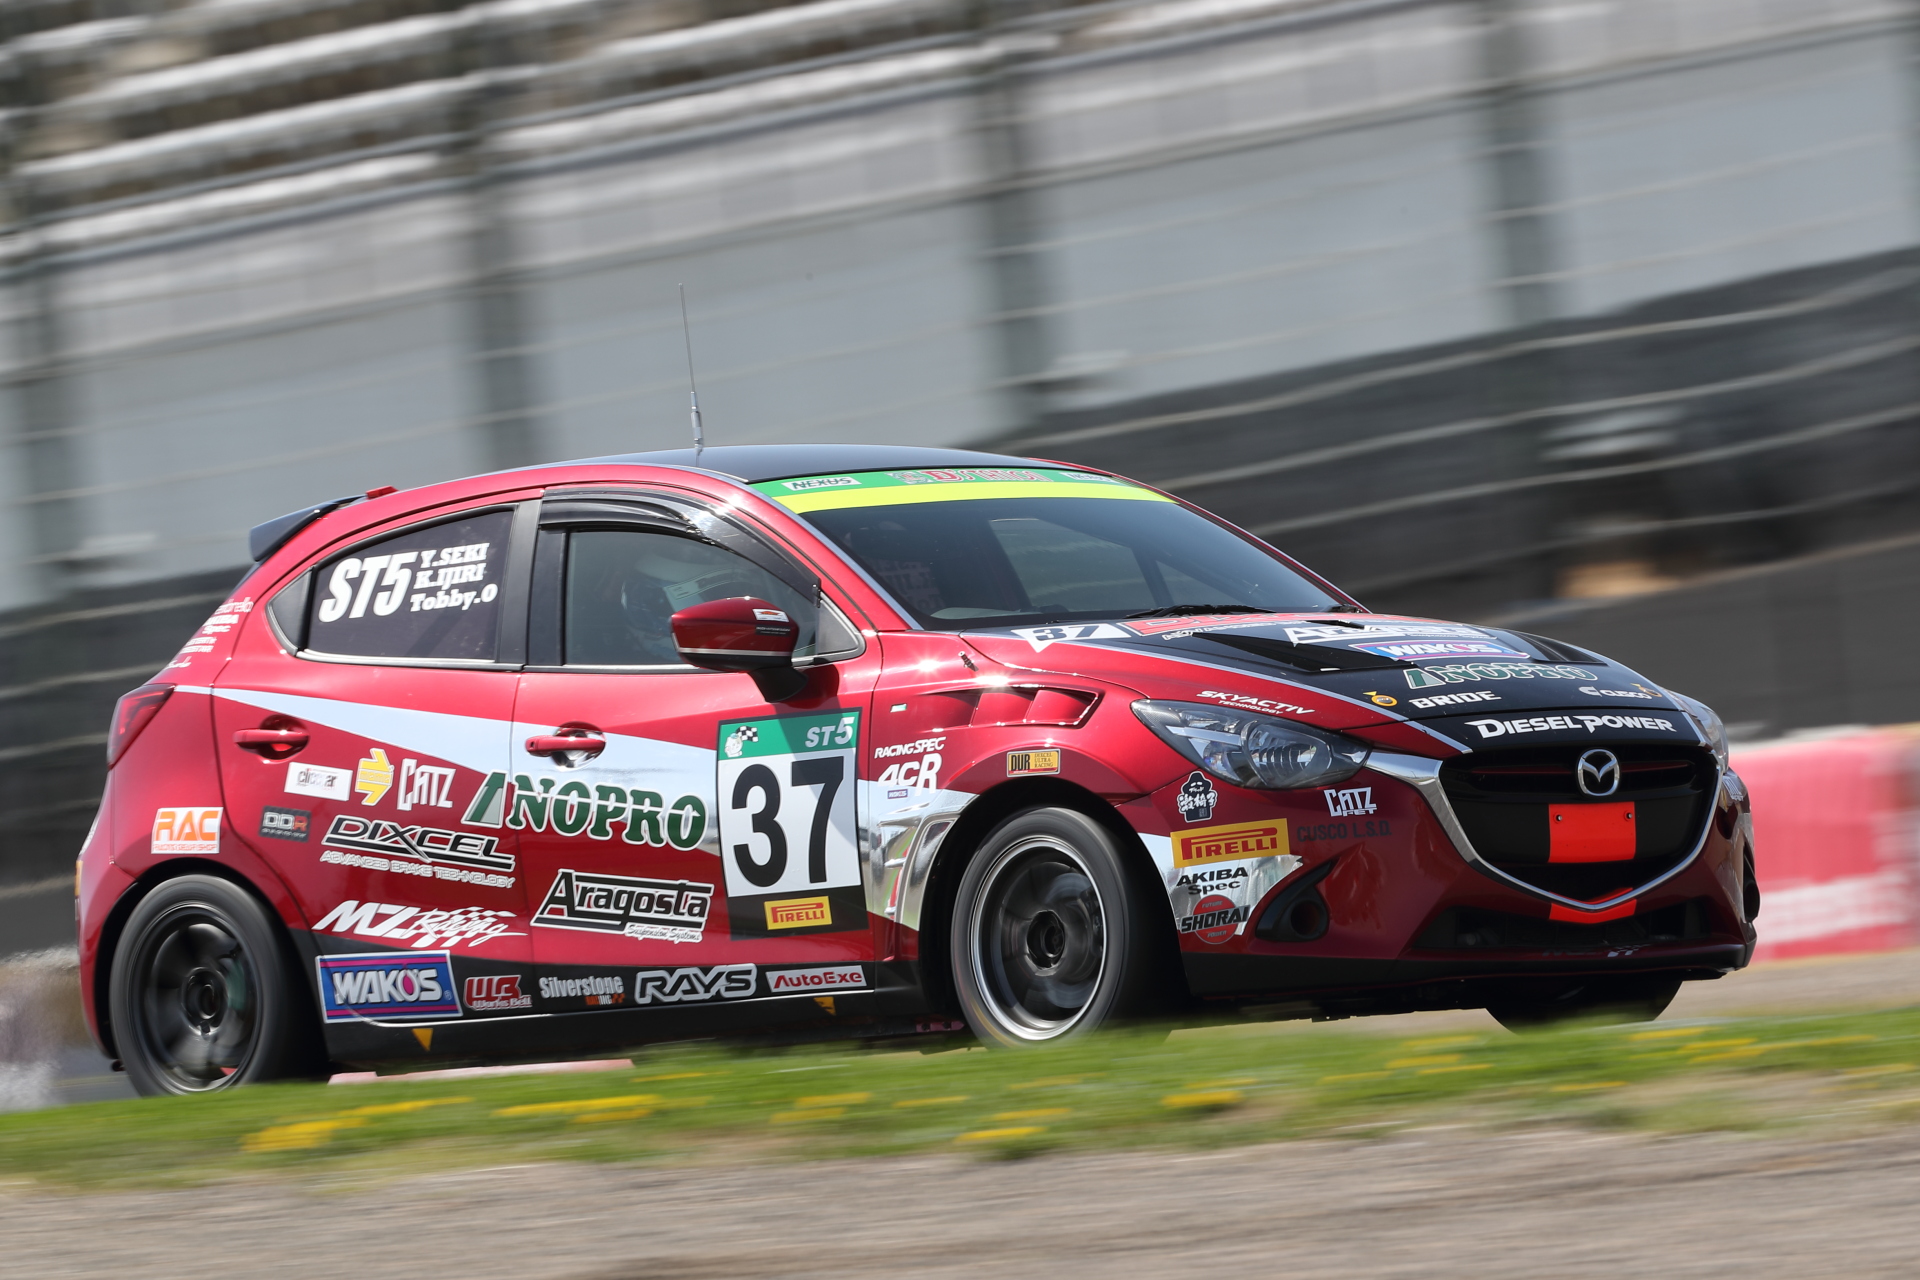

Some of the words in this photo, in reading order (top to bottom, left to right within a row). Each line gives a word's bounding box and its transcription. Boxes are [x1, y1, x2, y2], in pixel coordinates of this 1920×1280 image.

[792, 477, 852, 490] NEXUS
[421, 543, 490, 568] Y.SEKI
[318, 552, 418, 622] ST5
[413, 563, 487, 591] K.IJIRI
[410, 583, 498, 611] Tobby.O
[1033, 625, 1098, 641] 37
[1196, 690, 1316, 715] SKYACTIV
[1218, 700, 1284, 715] TECHNOLOGY
[1409, 690, 1502, 709] BRIDE
[804, 717, 855, 748] ST5
[877, 753, 942, 797] 4CR
[1010, 753, 1031, 771] DUR
[397, 758, 456, 811] CATZ
[156, 810, 221, 842] RAC
[262, 811, 308, 832] DDR
[732, 756, 844, 888] 37
[1297, 823, 1348, 843] CUSCO
[1353, 821, 1392, 839] L.S.D.
[325, 815, 515, 866] DIXCEL
[1181, 827, 1278, 861] PIRELLI
[320, 850, 389, 870] ADVANCED
[390, 860, 433, 877] BRAKE
[434, 867, 515, 889] TECHNOLOGY
[1176, 867, 1249, 887] AKIBA
[532, 870, 713, 929] Aragosta
[1188, 881, 1241, 896] Spec
[771, 902, 826, 924] PIRELLI
[1181, 905, 1250, 933] SHORAI
[332, 968, 443, 1005] WAKO'S
[539, 976, 624, 998] Silverstone
[635, 963, 757, 1004] RAYS
[774, 969, 863, 989] AutoExe
